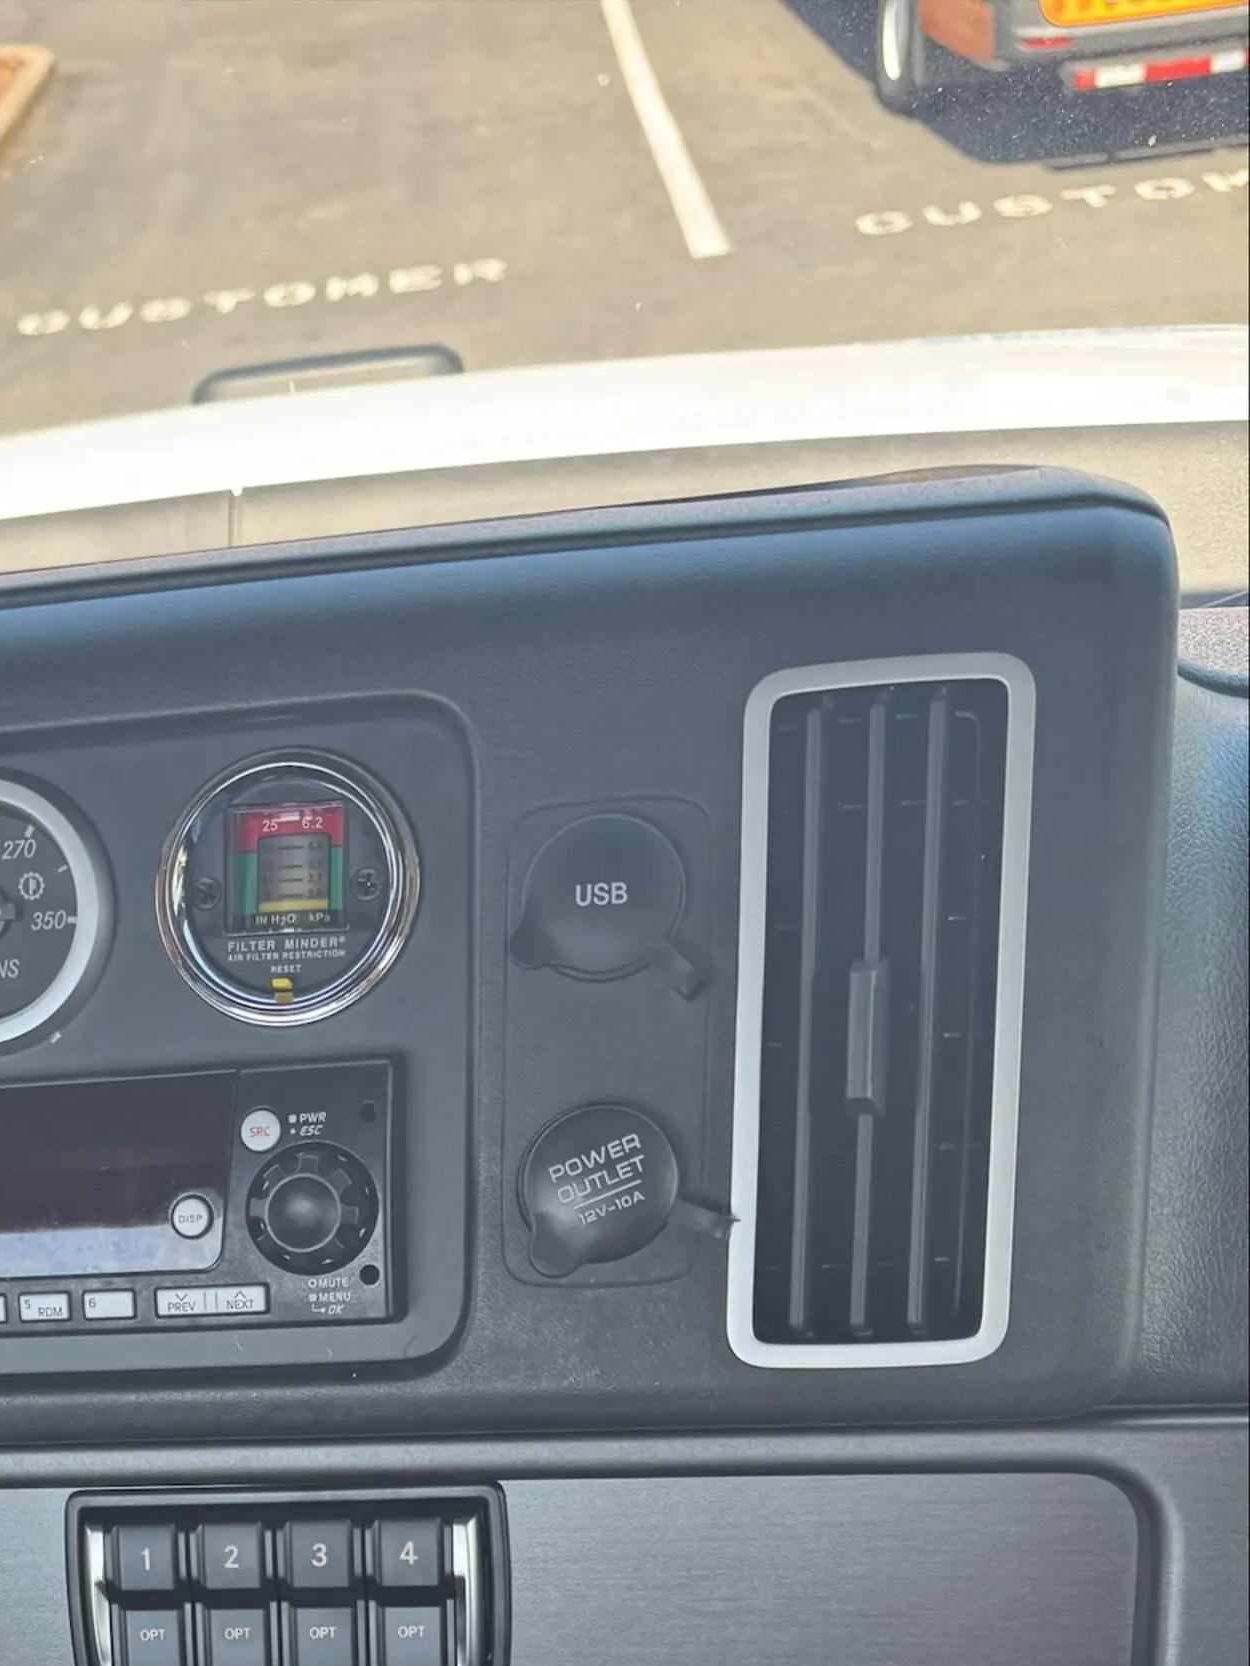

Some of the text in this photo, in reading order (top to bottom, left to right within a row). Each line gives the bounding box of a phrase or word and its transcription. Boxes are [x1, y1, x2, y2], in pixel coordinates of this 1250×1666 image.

[17, 258, 506, 336] CUSTOMER
[2, 839, 37, 861] 270
[575, 881, 628, 906] USB
[31, 911, 66, 931] 350
[227, 940, 275, 952] FILTER
[227, 949, 346, 962] AIR FILTER RESTRICTION
[271, 964, 301, 973] RESET
[299, 1112, 326, 1124] PWR
[249, 1126, 270, 1137] SRC
[299, 1124, 324, 1136] ESC
[547, 1132, 643, 1185] POWER
[557, 1154, 647, 1205] OUTLET
[578, 1190, 646, 1226] 12V-10A
[177, 1213, 203, 1225] DISP
[318, 1277, 349, 1289] MUTE
[318, 1291, 351, 1303] MENU
[38, 1306, 63, 1318] RDM
[167, 1301, 196, 1312] PREV
[226, 1299, 254, 1311] NEXT
[328, 1304, 344, 1315] OK
[141, 1547, 151, 1571] 1
[224, 1545, 239, 1569] 2
[311, 1543, 328, 1568] 3
[399, 1541, 418, 1565] 4
[139, 1628, 165, 1642] OPT
[224, 1626, 251, 1641] OPT
[309, 1625, 336, 1640] OPT
[397, 1624, 426, 1639] OPT
